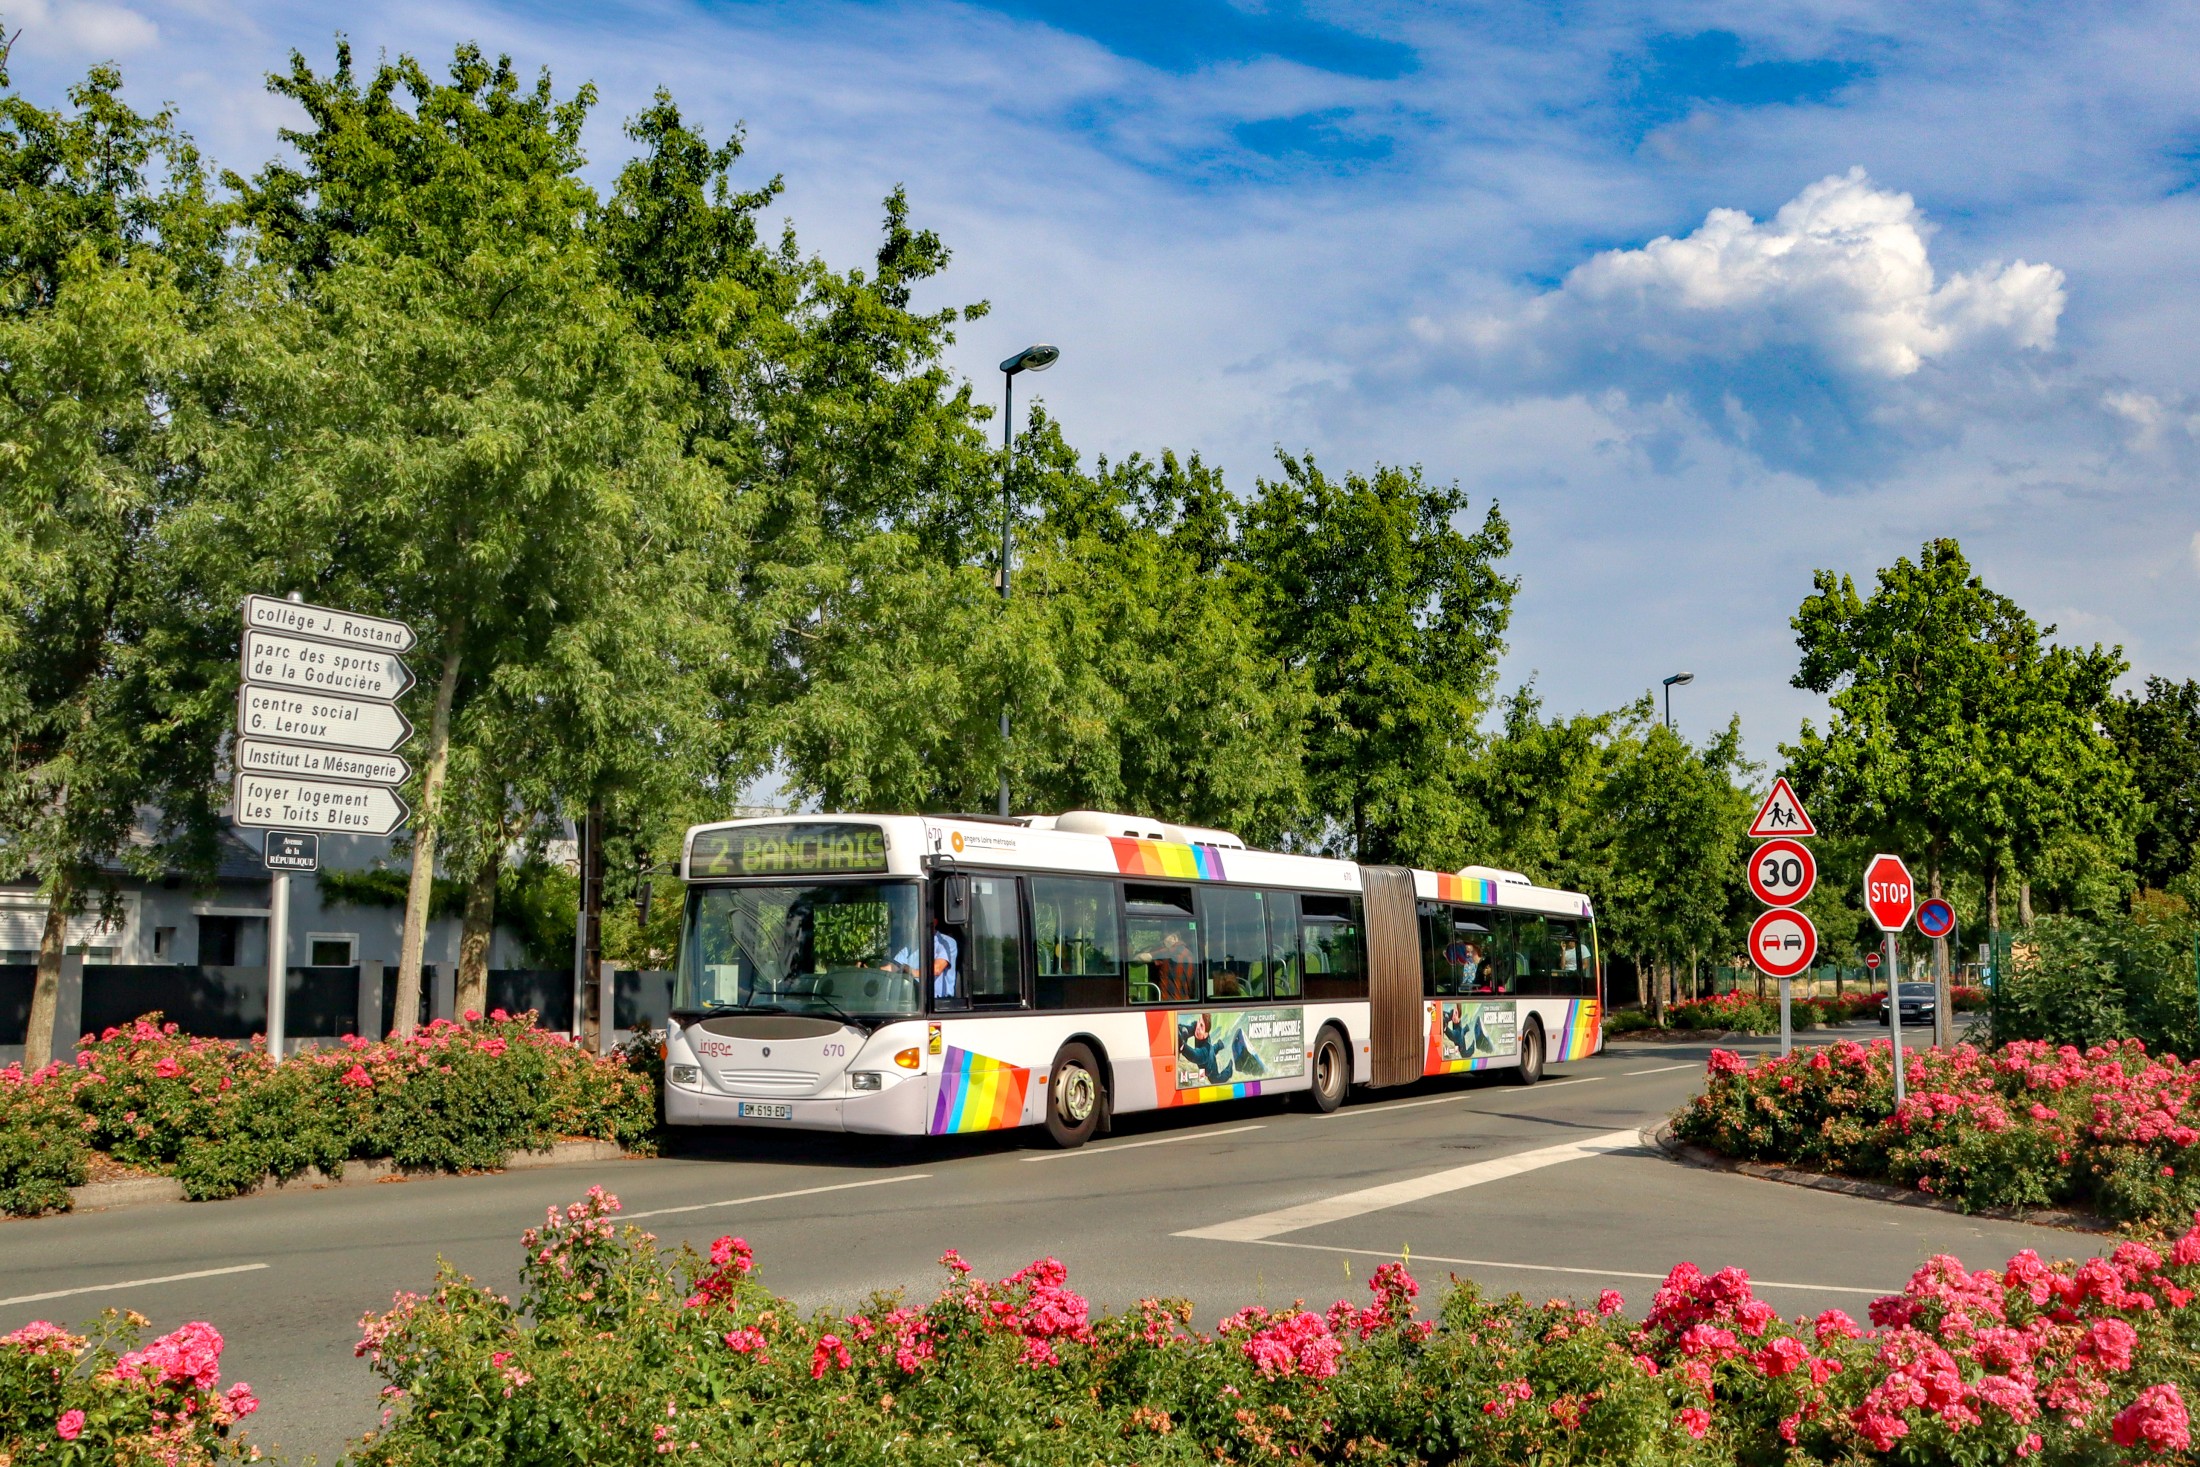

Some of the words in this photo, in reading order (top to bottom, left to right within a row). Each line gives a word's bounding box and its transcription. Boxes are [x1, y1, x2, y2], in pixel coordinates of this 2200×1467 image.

[257, 608, 314, 630] collège
[323, 618, 335, 632] J.
[343, 621, 402, 644] Rostand
[254, 643, 290, 658] parc
[300, 647, 325, 664] des
[333, 655, 380, 672] sports
[255, 660, 273, 675] de
[281, 663, 296, 679] la
[305, 667, 381, 691] Goducière
[252, 697, 303, 714] centre
[311, 704, 359, 721] social
[251, 713, 266, 729] G.
[276, 716, 327, 737] Leroux
[248, 747, 300, 767] Institut
[304, 753, 319, 769] La
[323, 756, 397, 778] Mésangerie
[248, 783, 289, 801] foyer
[297, 787, 369, 807] logement
[246, 802, 272, 818] Les
[283, 805, 319, 822] Toits
[328, 809, 370, 826] Bleus
[282, 837, 304, 845] Avenue
[285, 846, 292, 854] de
[293, 847, 300, 855] la
[963, 835, 980, 843] angers
[269, 854, 315, 866] RÉPUBLIQUE
[708, 836, 729, 873] 2
[742, 832, 885, 871] BANCHAIS
[1761, 858, 1802, 888] 30
[1871, 881, 1909, 904] STOP
[1272, 1020, 1301, 1037] IMPOSSIBLE
[823, 1044, 845, 1057] 670
